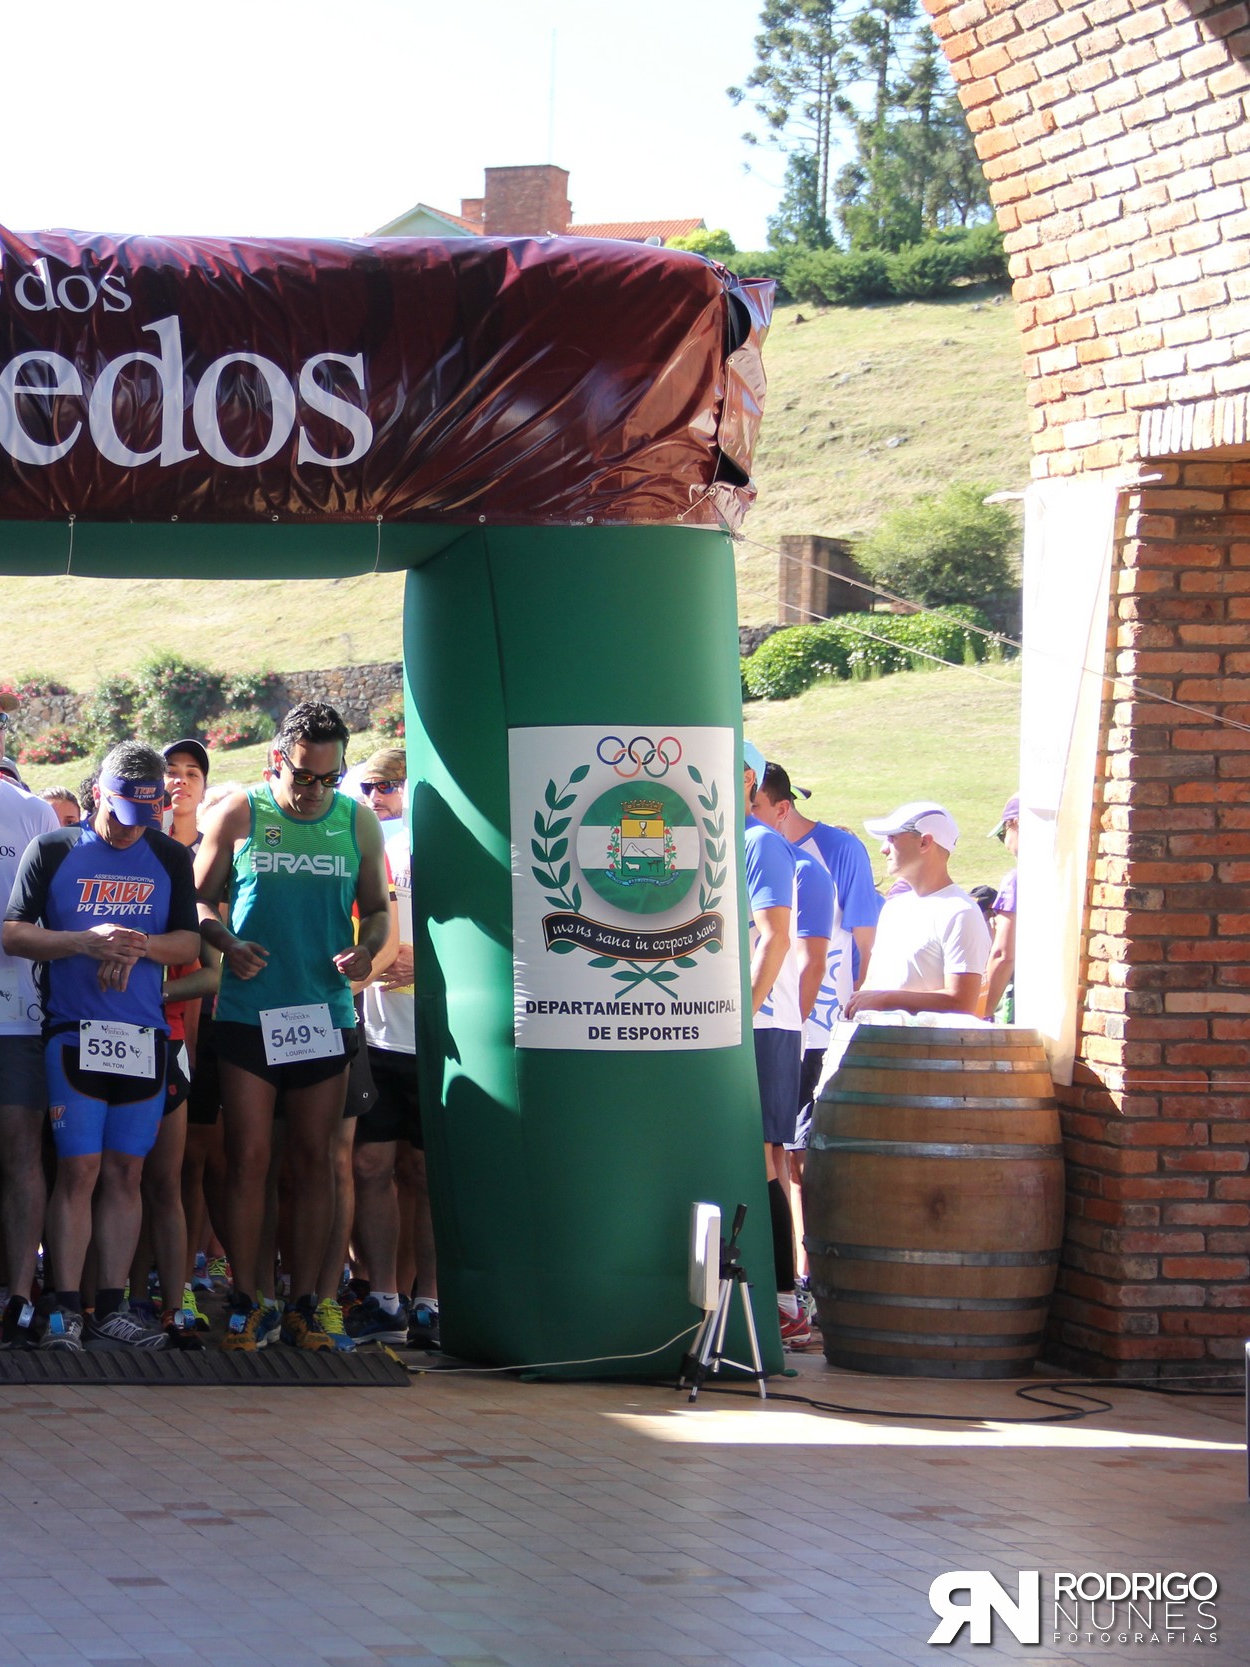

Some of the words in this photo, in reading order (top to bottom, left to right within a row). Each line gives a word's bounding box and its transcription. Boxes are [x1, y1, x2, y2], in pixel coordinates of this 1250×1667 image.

[15, 257, 133, 313] dos
[251, 851, 351, 877] BRASIL
[77, 878, 155, 903] TRIBO
[93, 904, 153, 916] ESPORTE
[553, 924, 592, 937] mens
[596, 931, 631, 949] sana
[635, 936, 649, 950] in
[652, 935, 693, 956] corpore
[696, 920, 717, 940] sano
[526, 1000, 666, 1016] DEPARTAMENTO
[671, 999, 736, 1015] MUNICIPAL
[272, 1025, 311, 1048] 549
[588, 1026, 611, 1040] DE
[617, 1026, 700, 1040] ESPORTES
[88, 1038, 126, 1058] 536
[286, 1048, 316, 1057] LOURIVAL
